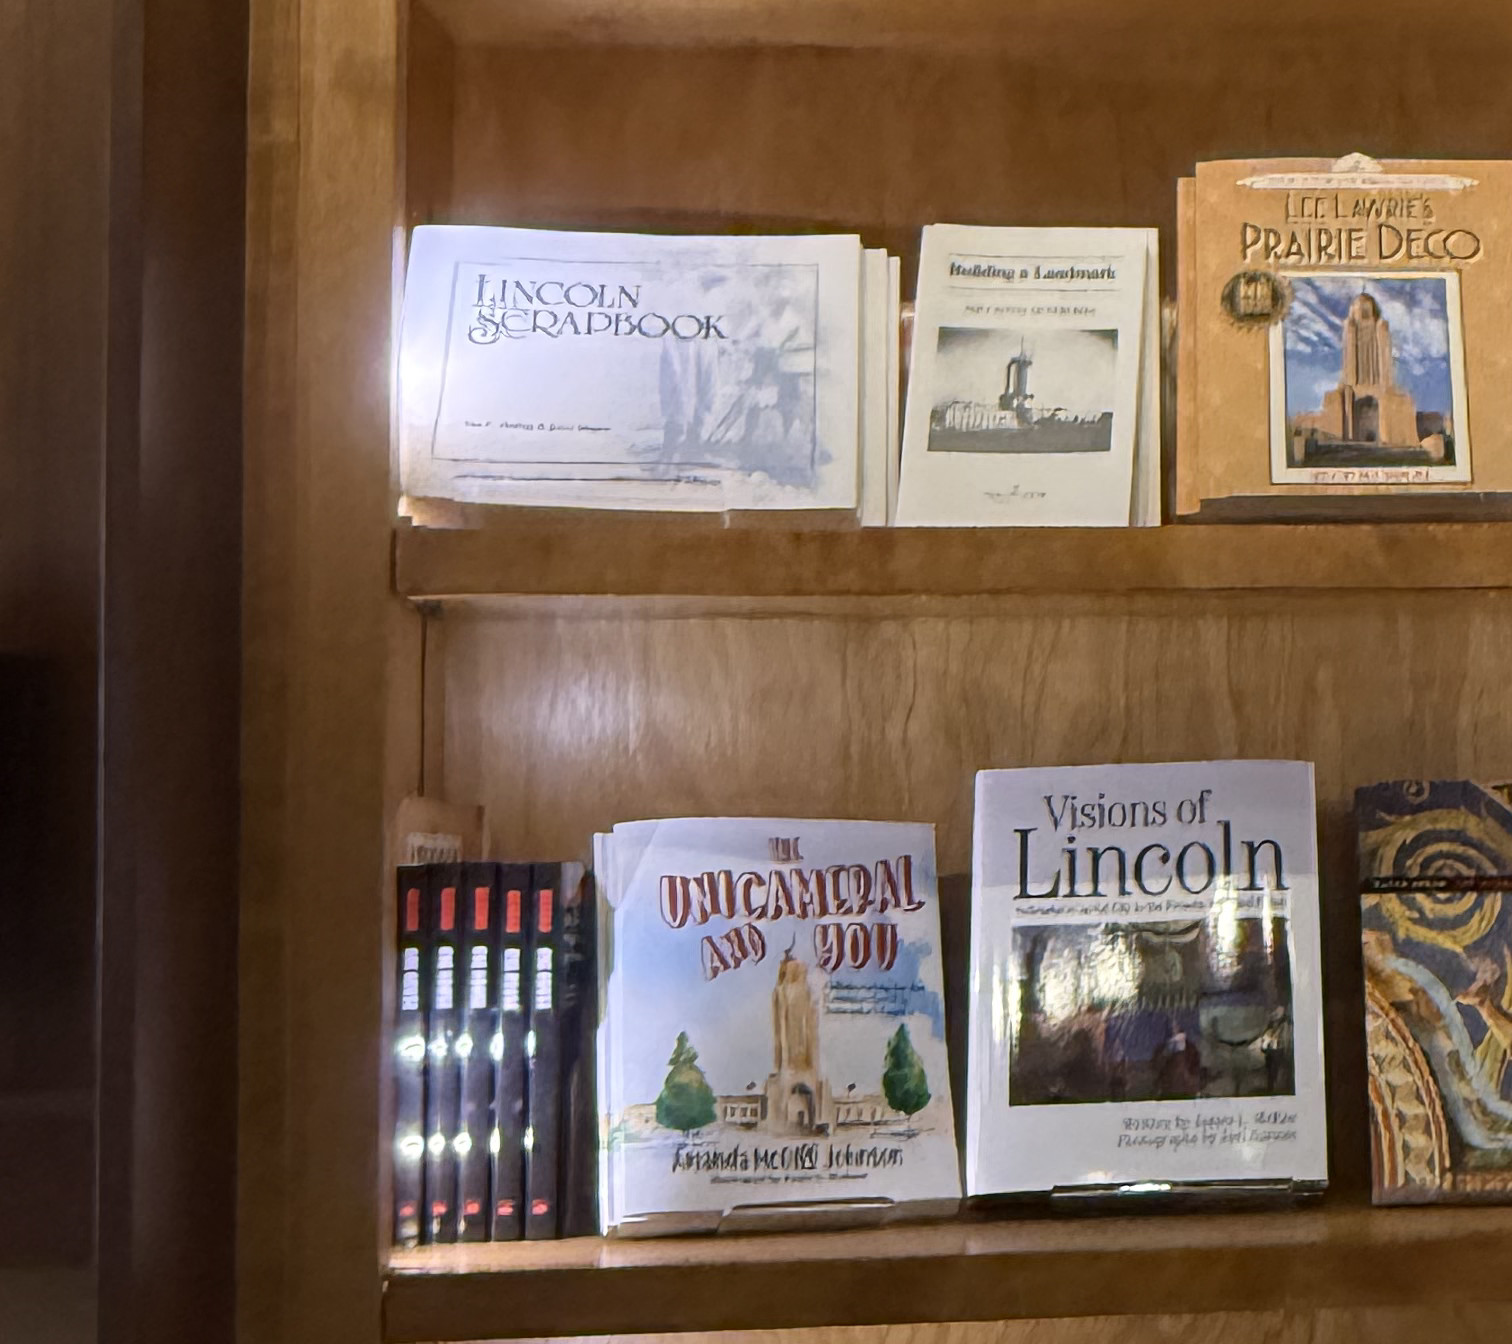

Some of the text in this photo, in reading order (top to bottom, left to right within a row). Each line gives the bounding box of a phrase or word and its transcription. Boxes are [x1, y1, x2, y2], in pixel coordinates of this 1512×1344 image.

[1241, 222, 1481, 263] PRAIRIE DECO
[472, 273, 642, 309] LINCOLN
[467, 306, 729, 345] SCRAPBOOK
[1044, 789, 1213, 831] Visions of
[1014, 820, 1290, 900] Lincoln
[659, 855, 926, 928] UNICAMERAL
[702, 922, 899, 981] AND YOU
